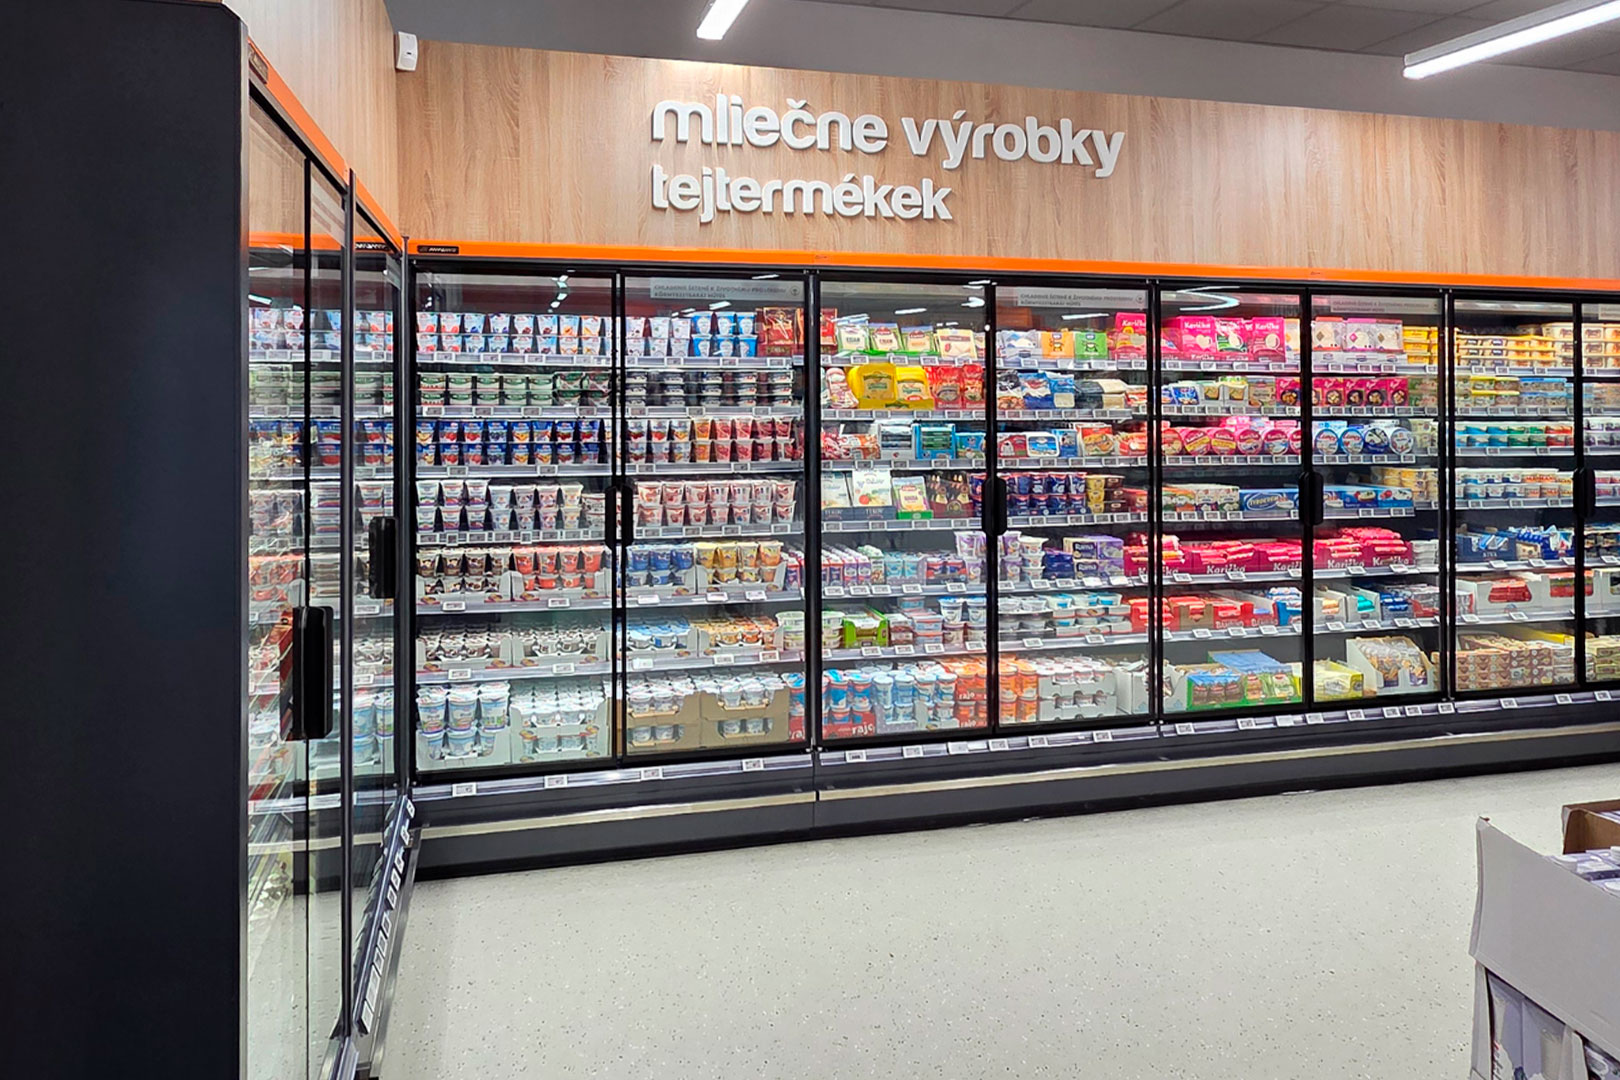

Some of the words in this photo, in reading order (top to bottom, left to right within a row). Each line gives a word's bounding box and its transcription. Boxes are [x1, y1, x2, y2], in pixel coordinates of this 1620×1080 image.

[651, 93, 888, 154] mliečne
[902, 110, 1126, 178] výrobky
[651, 164, 953, 224] tejtermékek
